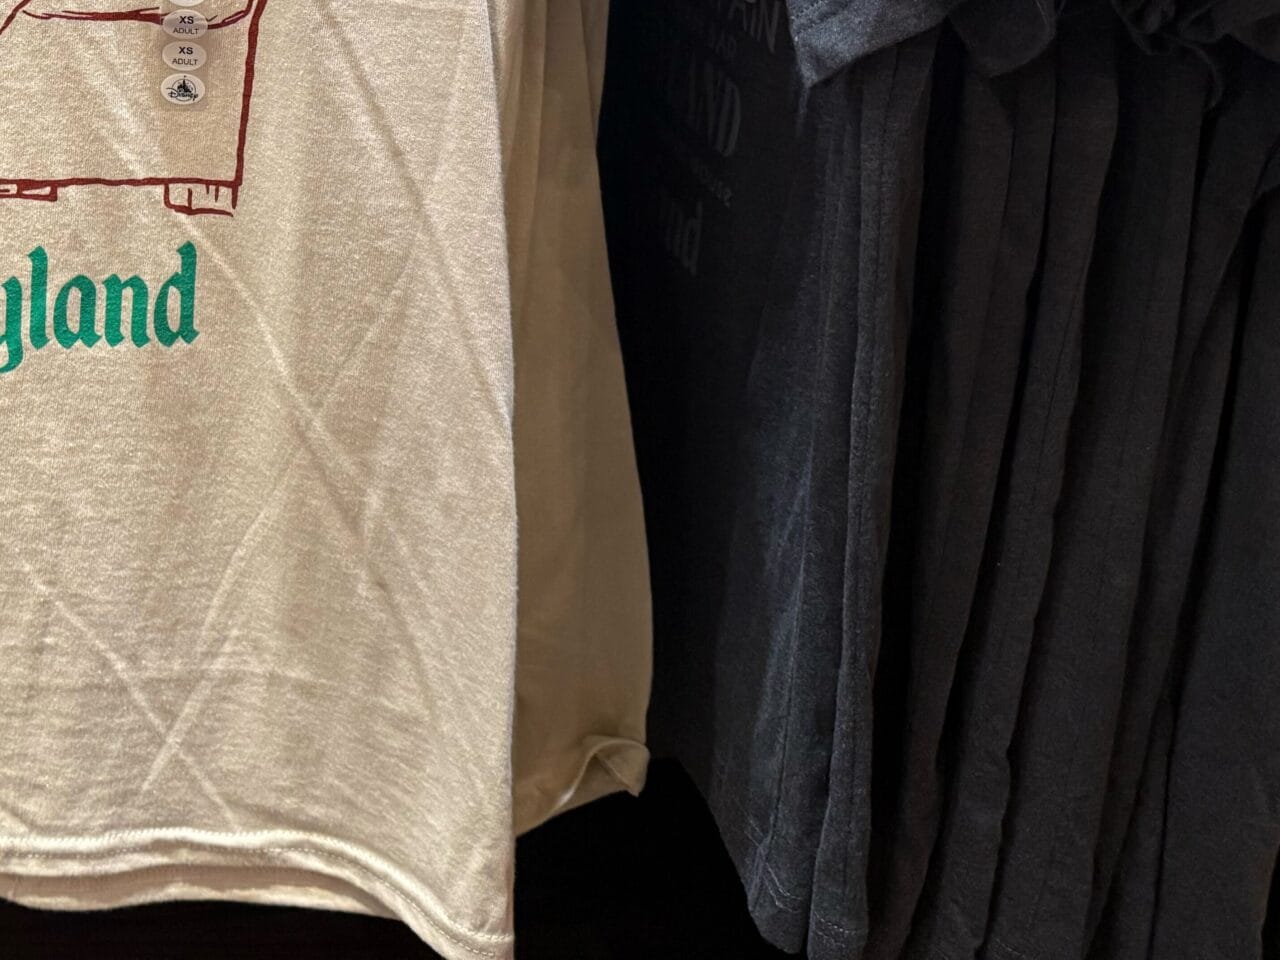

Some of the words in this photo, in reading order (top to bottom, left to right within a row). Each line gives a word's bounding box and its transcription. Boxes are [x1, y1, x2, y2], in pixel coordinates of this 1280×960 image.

[179, 15, 194, 25] XS
[172, 27, 199, 35] ADULT
[178, 46, 194, 55] XS
[171, 58, 198, 66] ADULT
[166, 87, 199, 101] Disney
